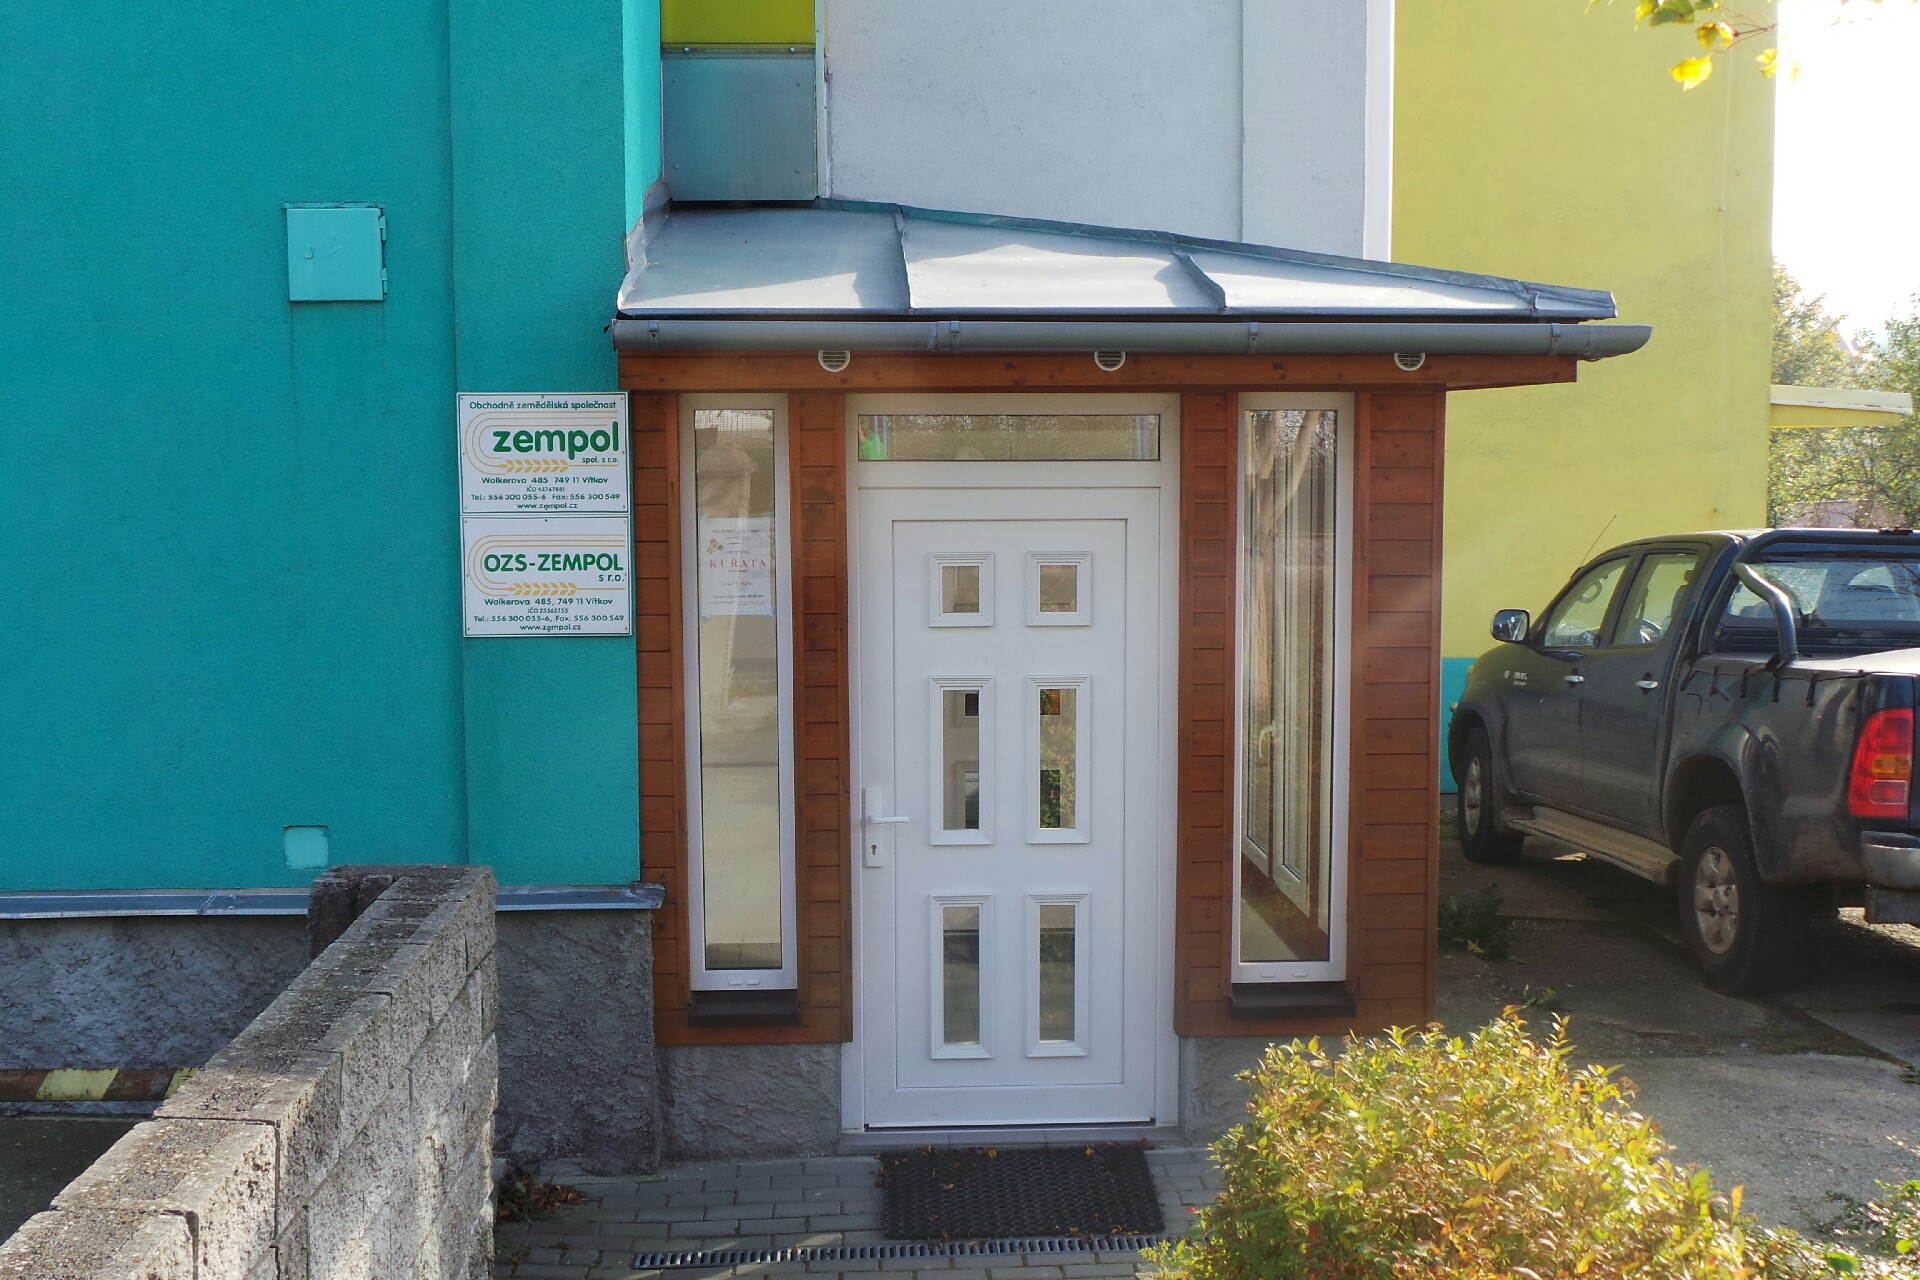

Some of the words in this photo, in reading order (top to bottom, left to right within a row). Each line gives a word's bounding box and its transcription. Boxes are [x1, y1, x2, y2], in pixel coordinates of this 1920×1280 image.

[469, 401, 515, 409] Obchodně
[517, 401, 569, 409] zemědělská
[571, 401, 617, 410] společnost
[492, 420, 619, 460] zempol
[582, 456, 600, 464] spol.
[484, 553, 624, 572] OZS-ZEMPOL
[709, 557, 766, 568] KUŘATA
[534, 598, 555, 606] 485,
